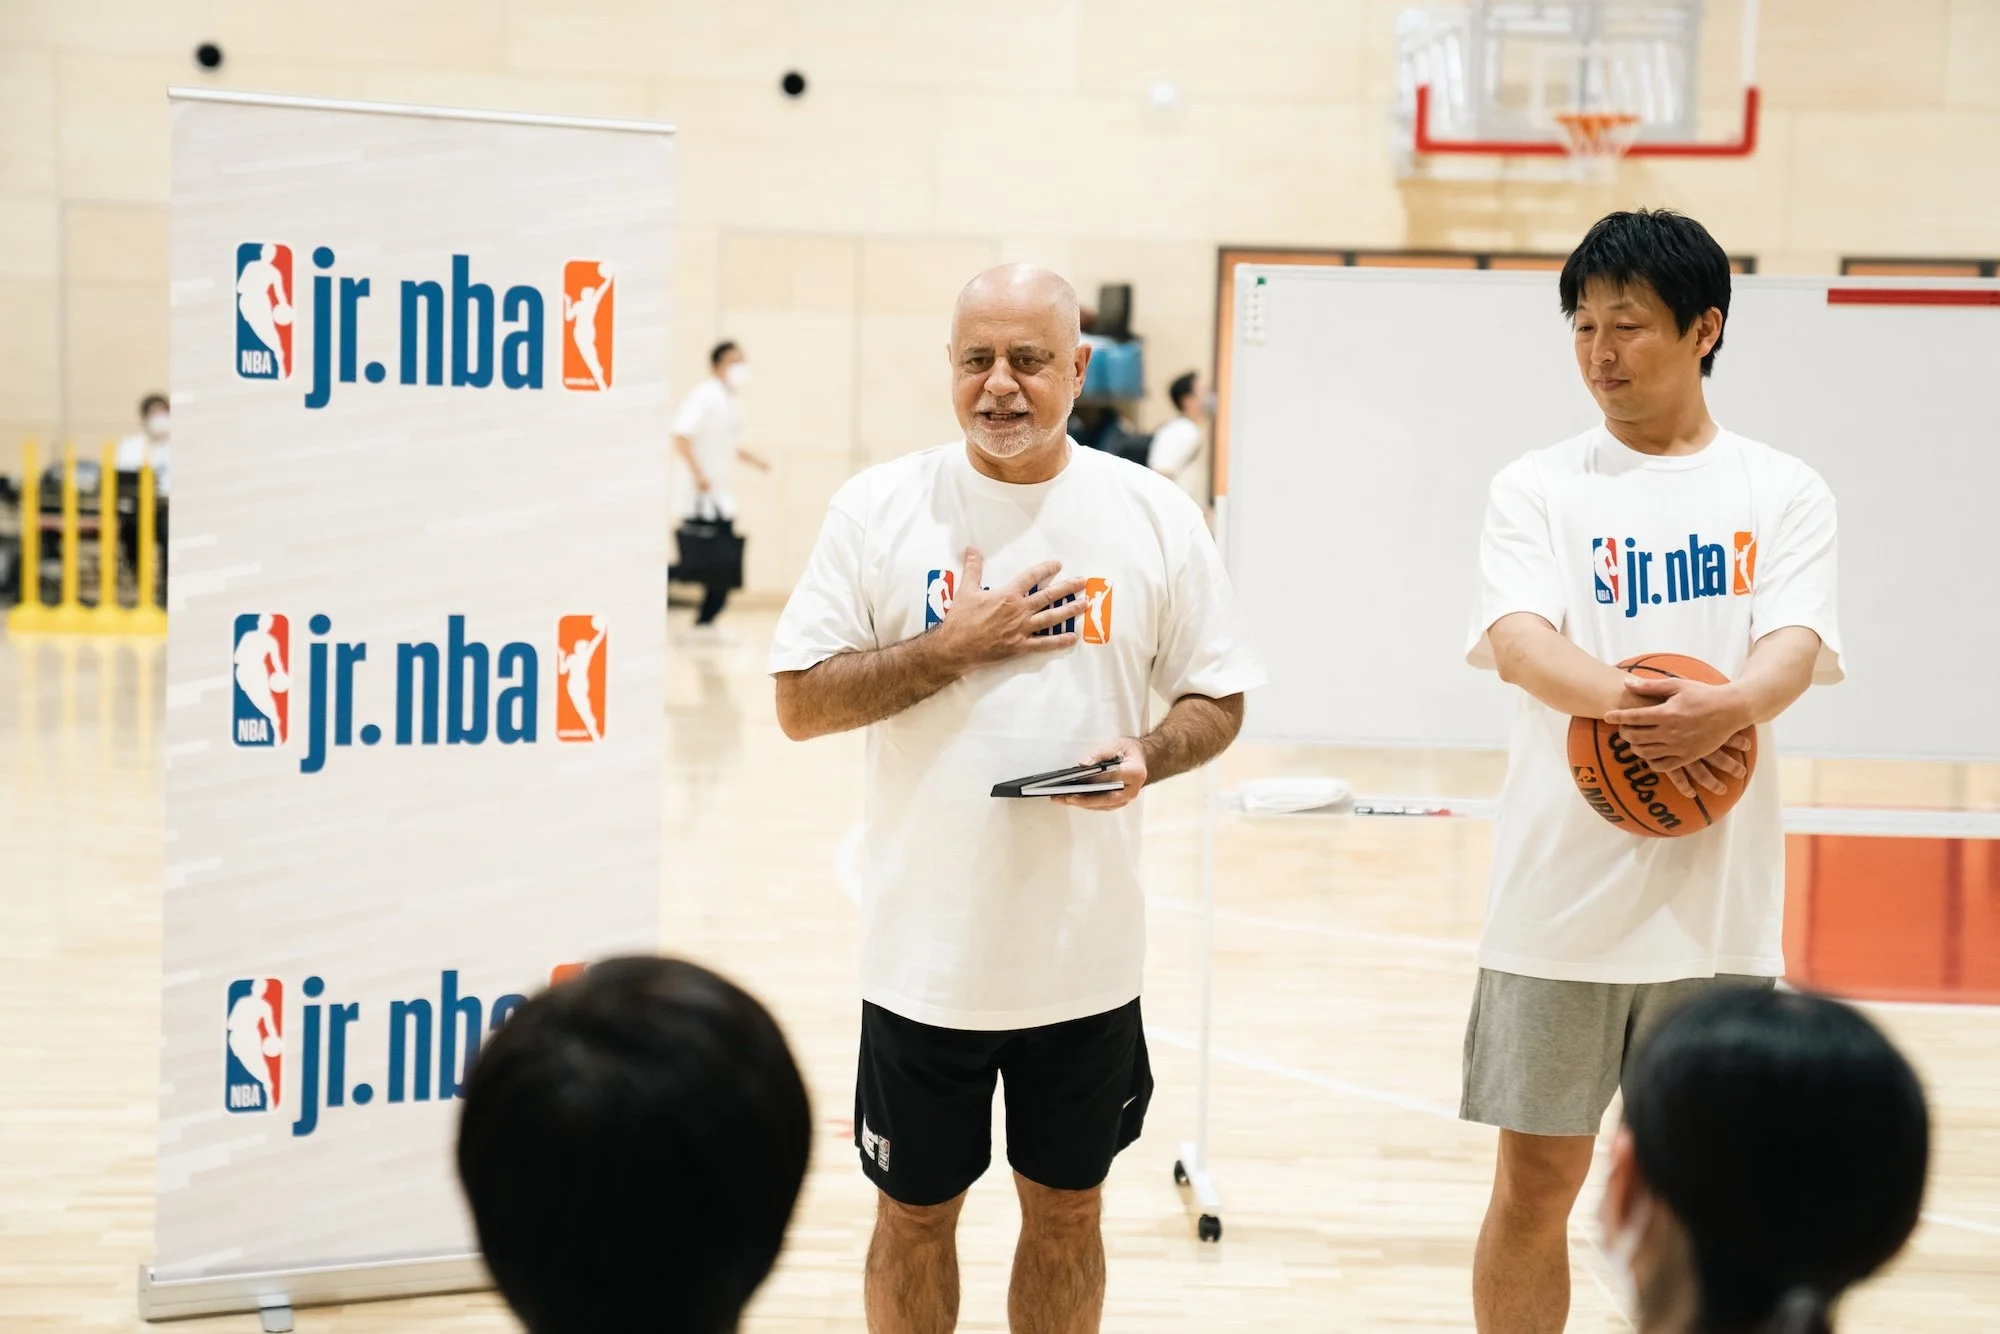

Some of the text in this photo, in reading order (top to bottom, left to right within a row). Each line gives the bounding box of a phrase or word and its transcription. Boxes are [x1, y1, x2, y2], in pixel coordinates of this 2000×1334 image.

[400, 254, 544, 390] nba
[241, 349, 272, 375] NBA
[1597, 588, 1611, 601] NBA
[396, 614, 539, 745] nba
[238, 717, 268, 743] NBA
[1580, 787, 1625, 822] NBA
[230, 1083, 261, 1109] NBA
